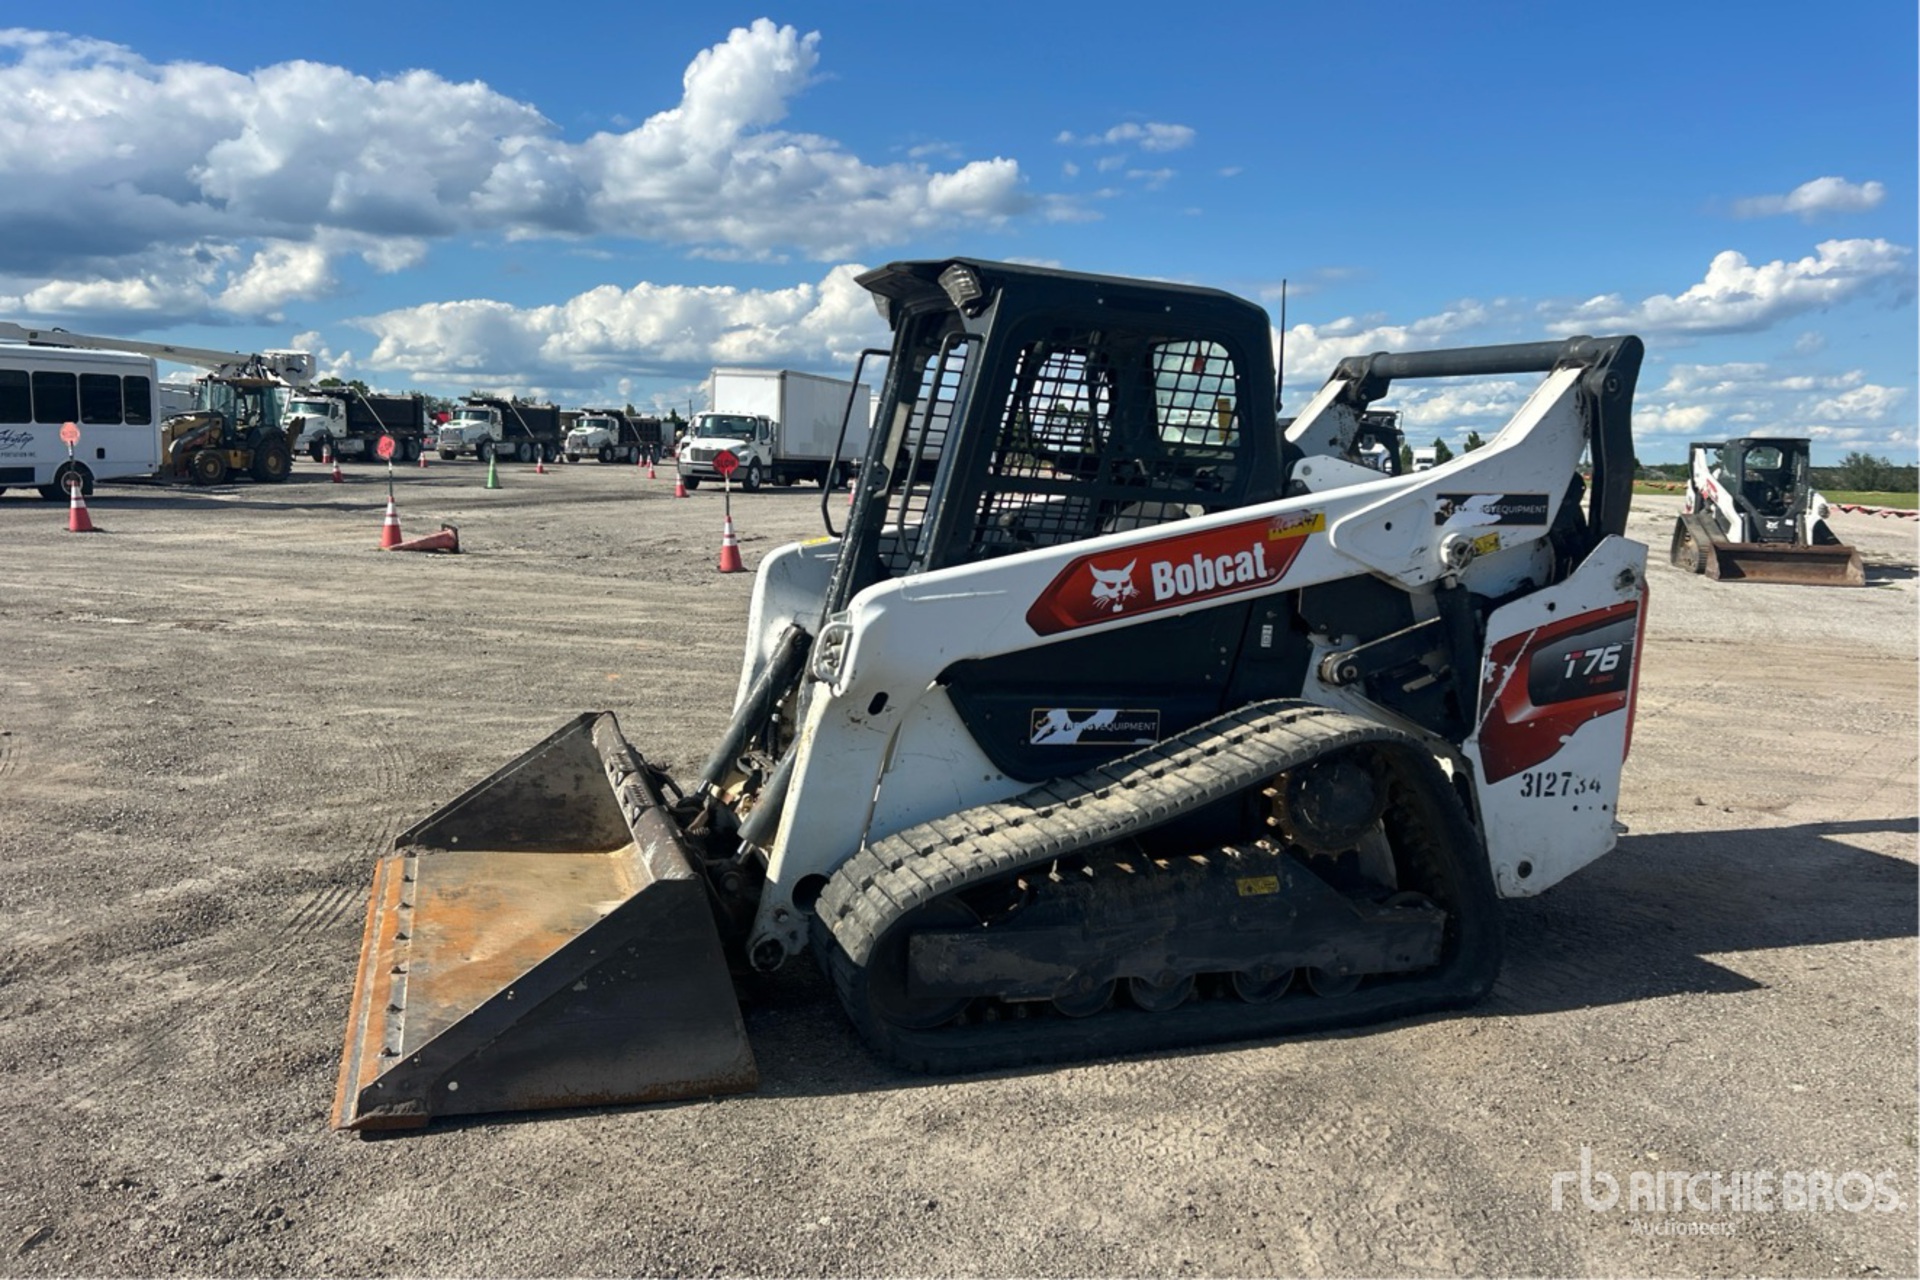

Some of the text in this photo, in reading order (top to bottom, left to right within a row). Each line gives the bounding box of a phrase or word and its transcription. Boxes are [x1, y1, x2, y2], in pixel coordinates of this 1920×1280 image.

[1151, 542, 1267, 601] Bobcat
[1563, 645, 1623, 679] T76
[1520, 771, 1601, 797] 312734
